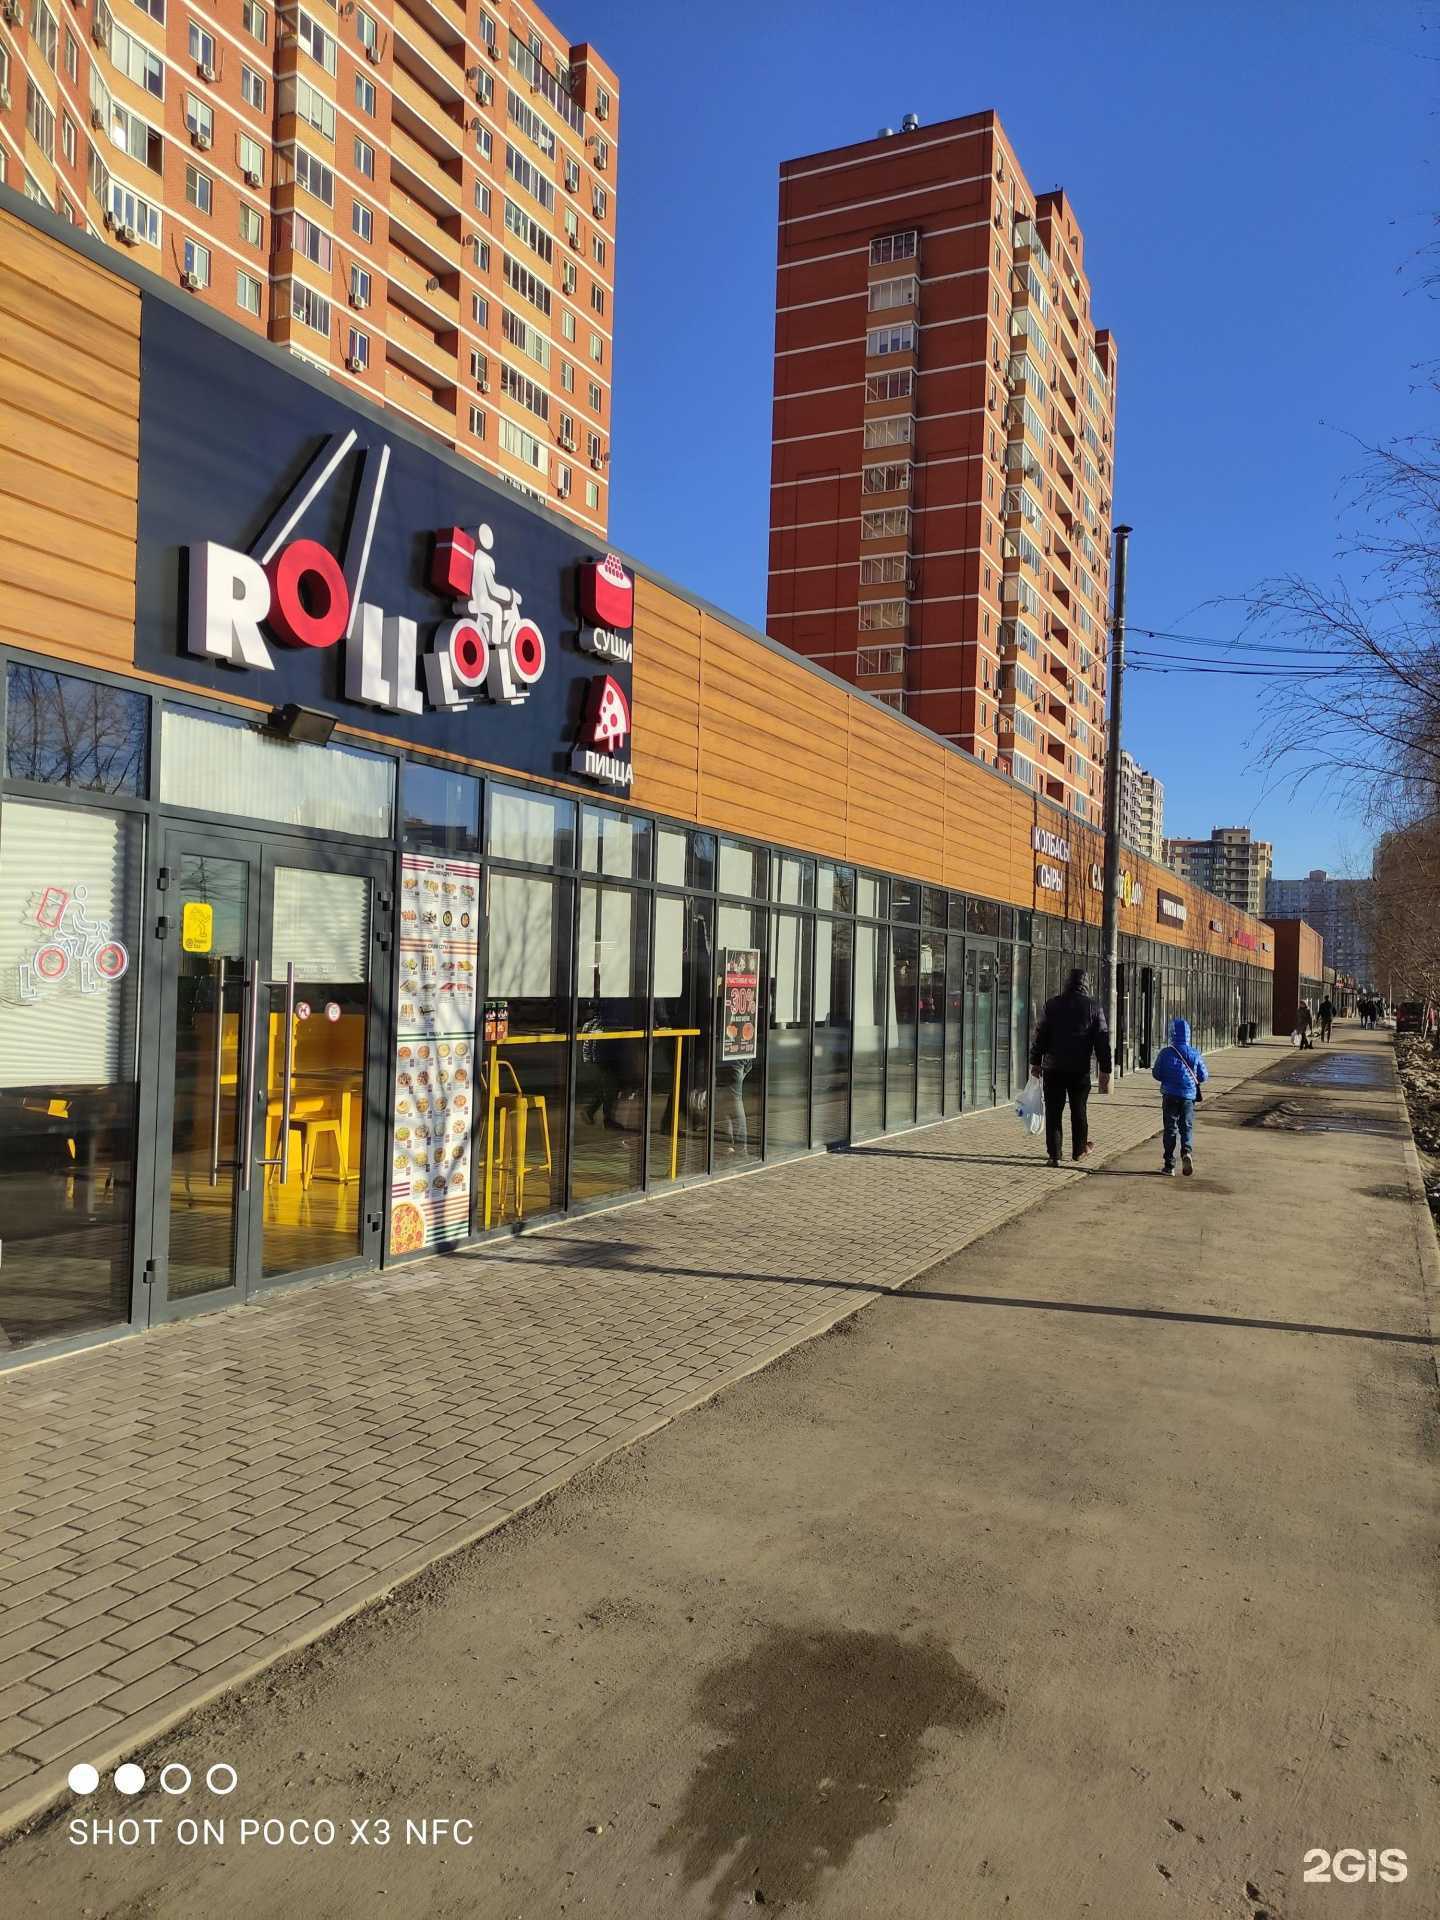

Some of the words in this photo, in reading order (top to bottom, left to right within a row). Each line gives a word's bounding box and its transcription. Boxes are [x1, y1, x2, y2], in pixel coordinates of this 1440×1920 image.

[593, 627, 633, 664] СУШИ
[585, 750, 634, 787] ПИЦЦА
[1035, 826, 1070, 863] КОЛБАСЫ
[1041, 864, 1063, 892] СЫРЫ
